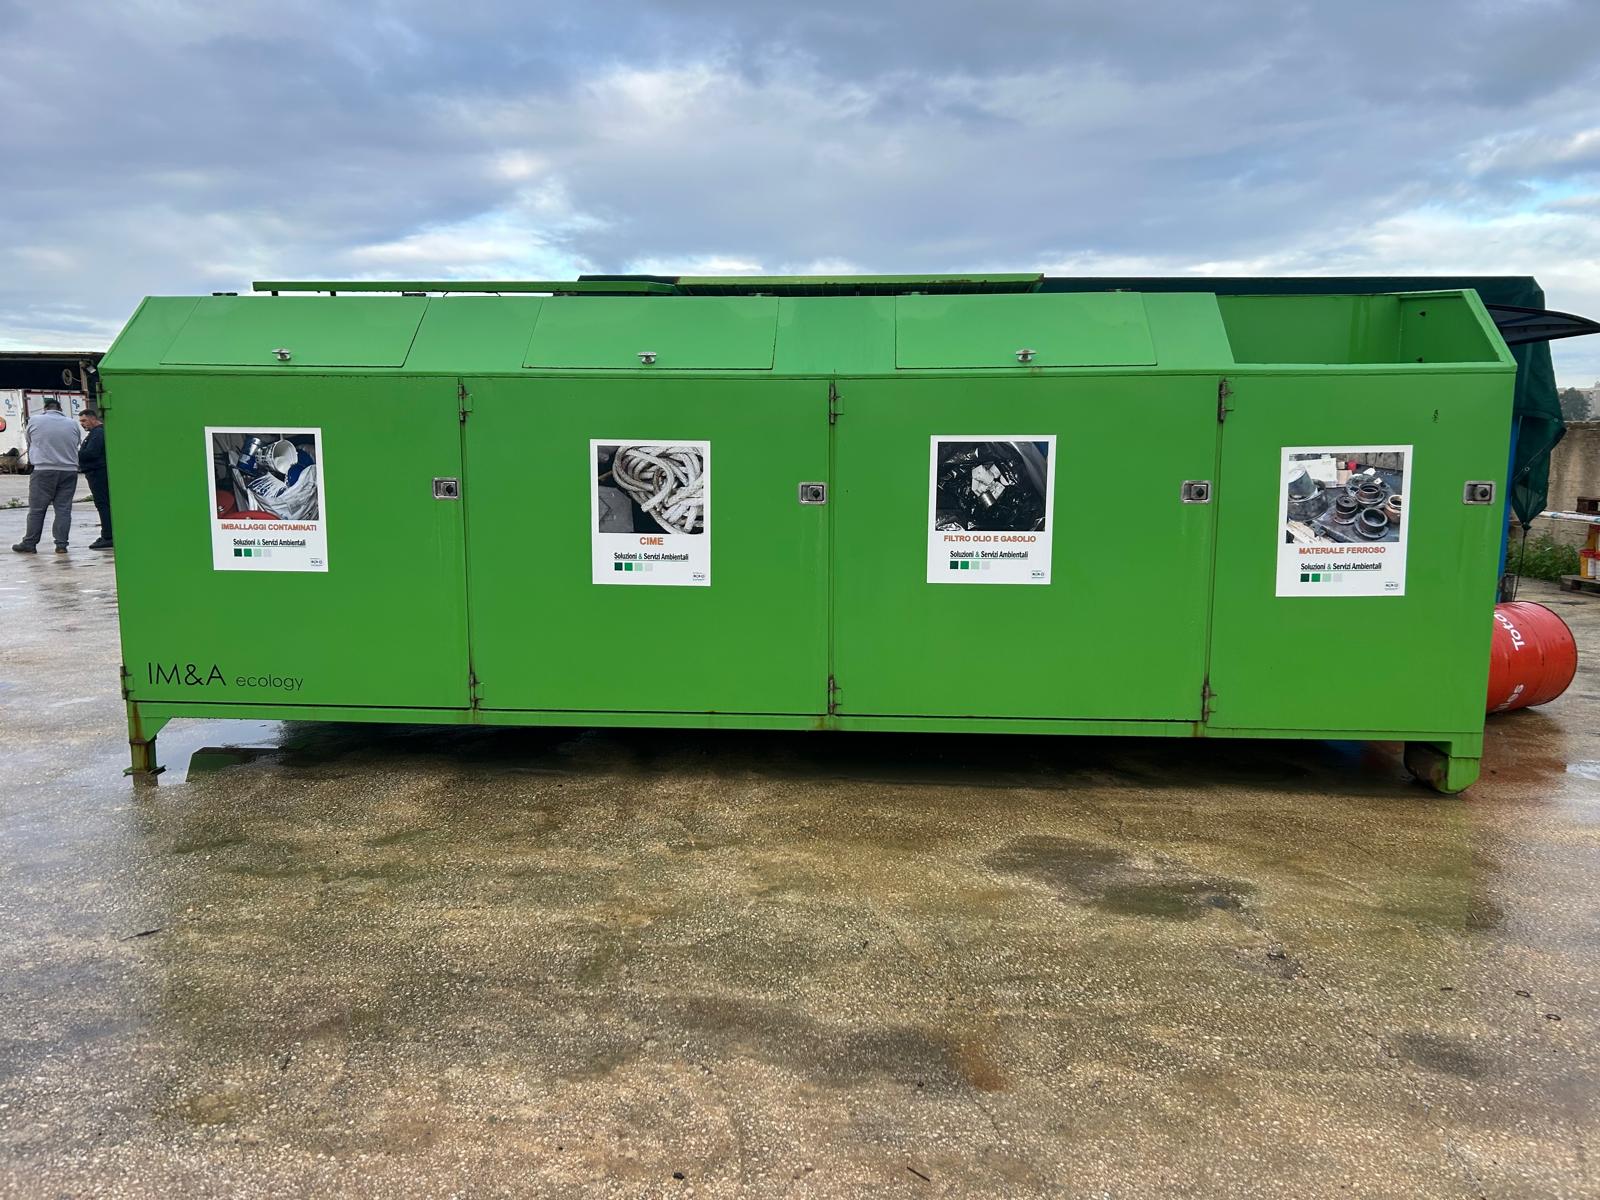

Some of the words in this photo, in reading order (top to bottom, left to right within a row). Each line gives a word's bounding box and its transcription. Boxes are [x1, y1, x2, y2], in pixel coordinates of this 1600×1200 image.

[221, 523, 267, 531] IMBALLAGGI
[639, 537, 664, 545] CIME
[1000, 535, 1037, 543] GASOLIO
[1346, 546, 1386, 554] FERROSO
[1351, 562, 1382, 570] Ambientali
[1494, 612, 1525, 651] Tota
[148, 662, 227, 686] IM&A
[236, 674, 304, 691] ecology
